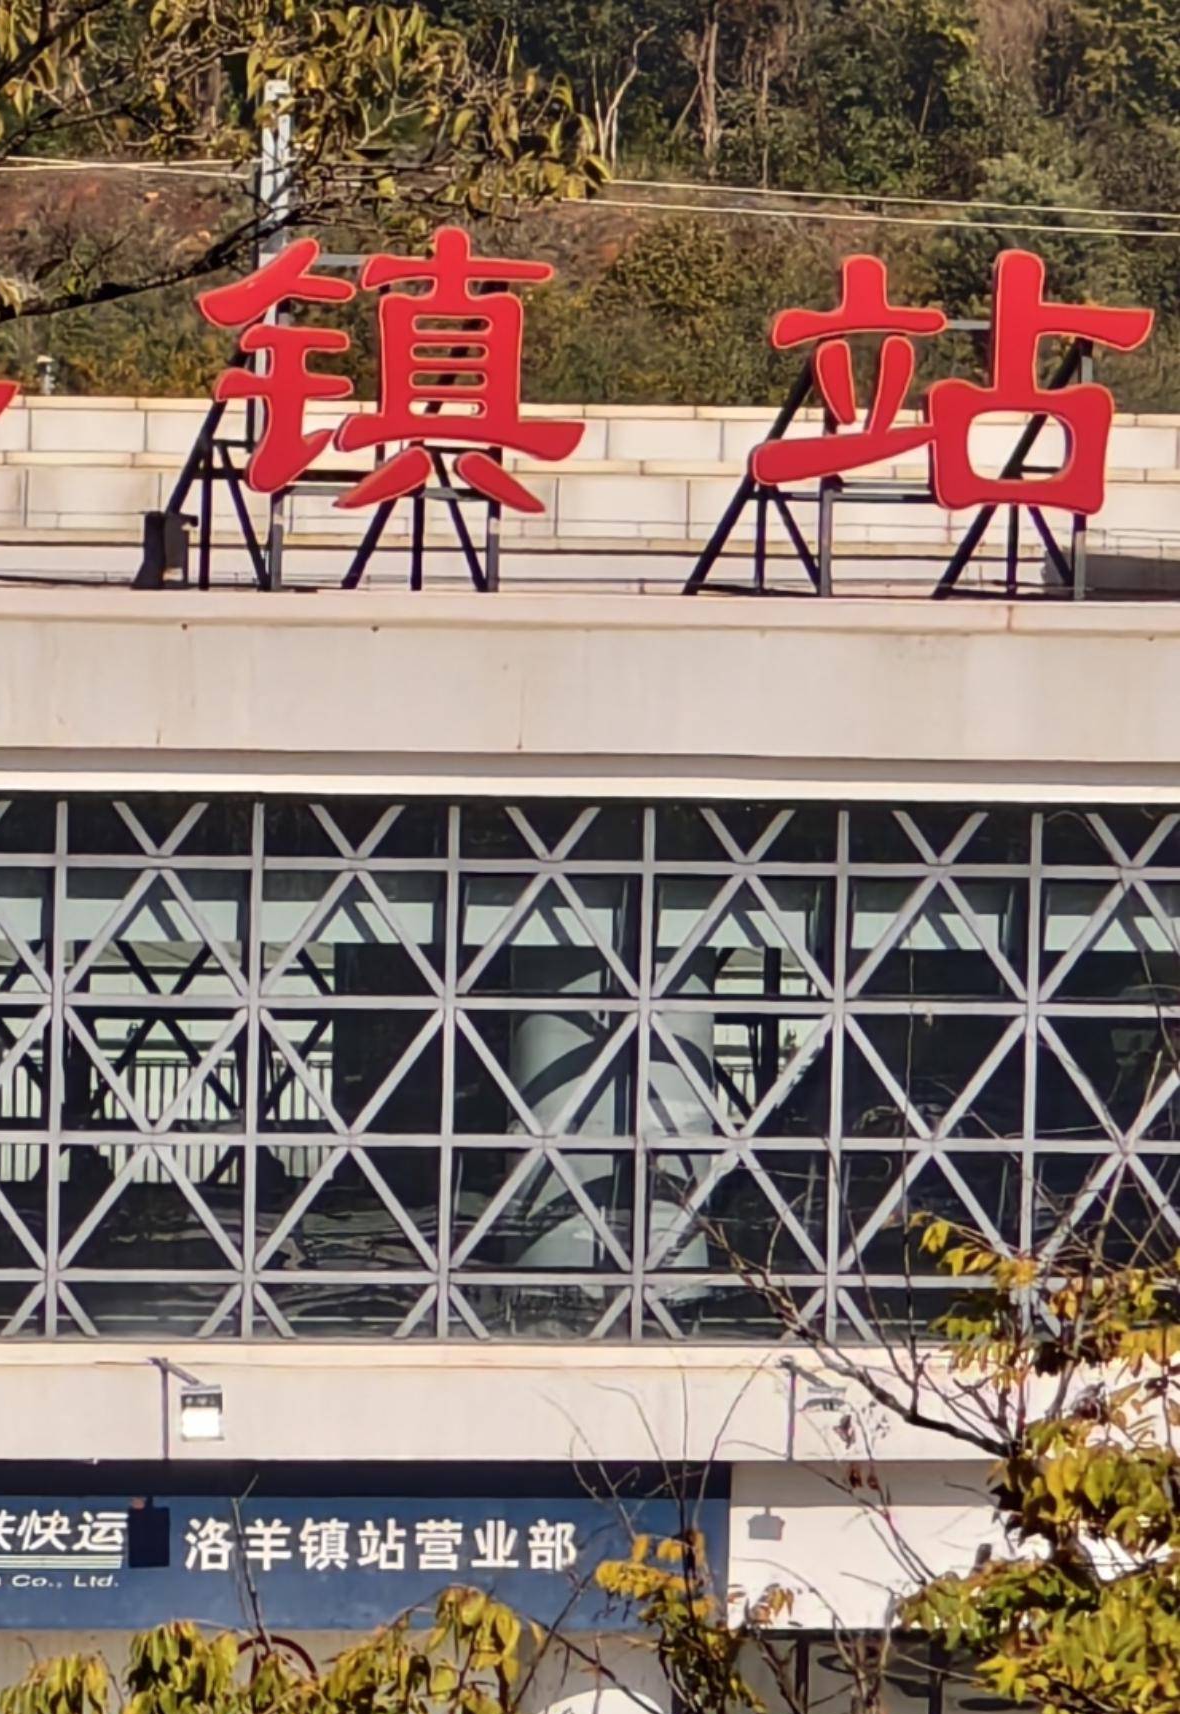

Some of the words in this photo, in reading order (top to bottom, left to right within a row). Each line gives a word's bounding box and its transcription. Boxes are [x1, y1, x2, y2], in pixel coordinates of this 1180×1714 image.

[184, 1517, 579, 1572] 洛羊镇站营业部
[73, 1574, 120, 1588] Ltd.
